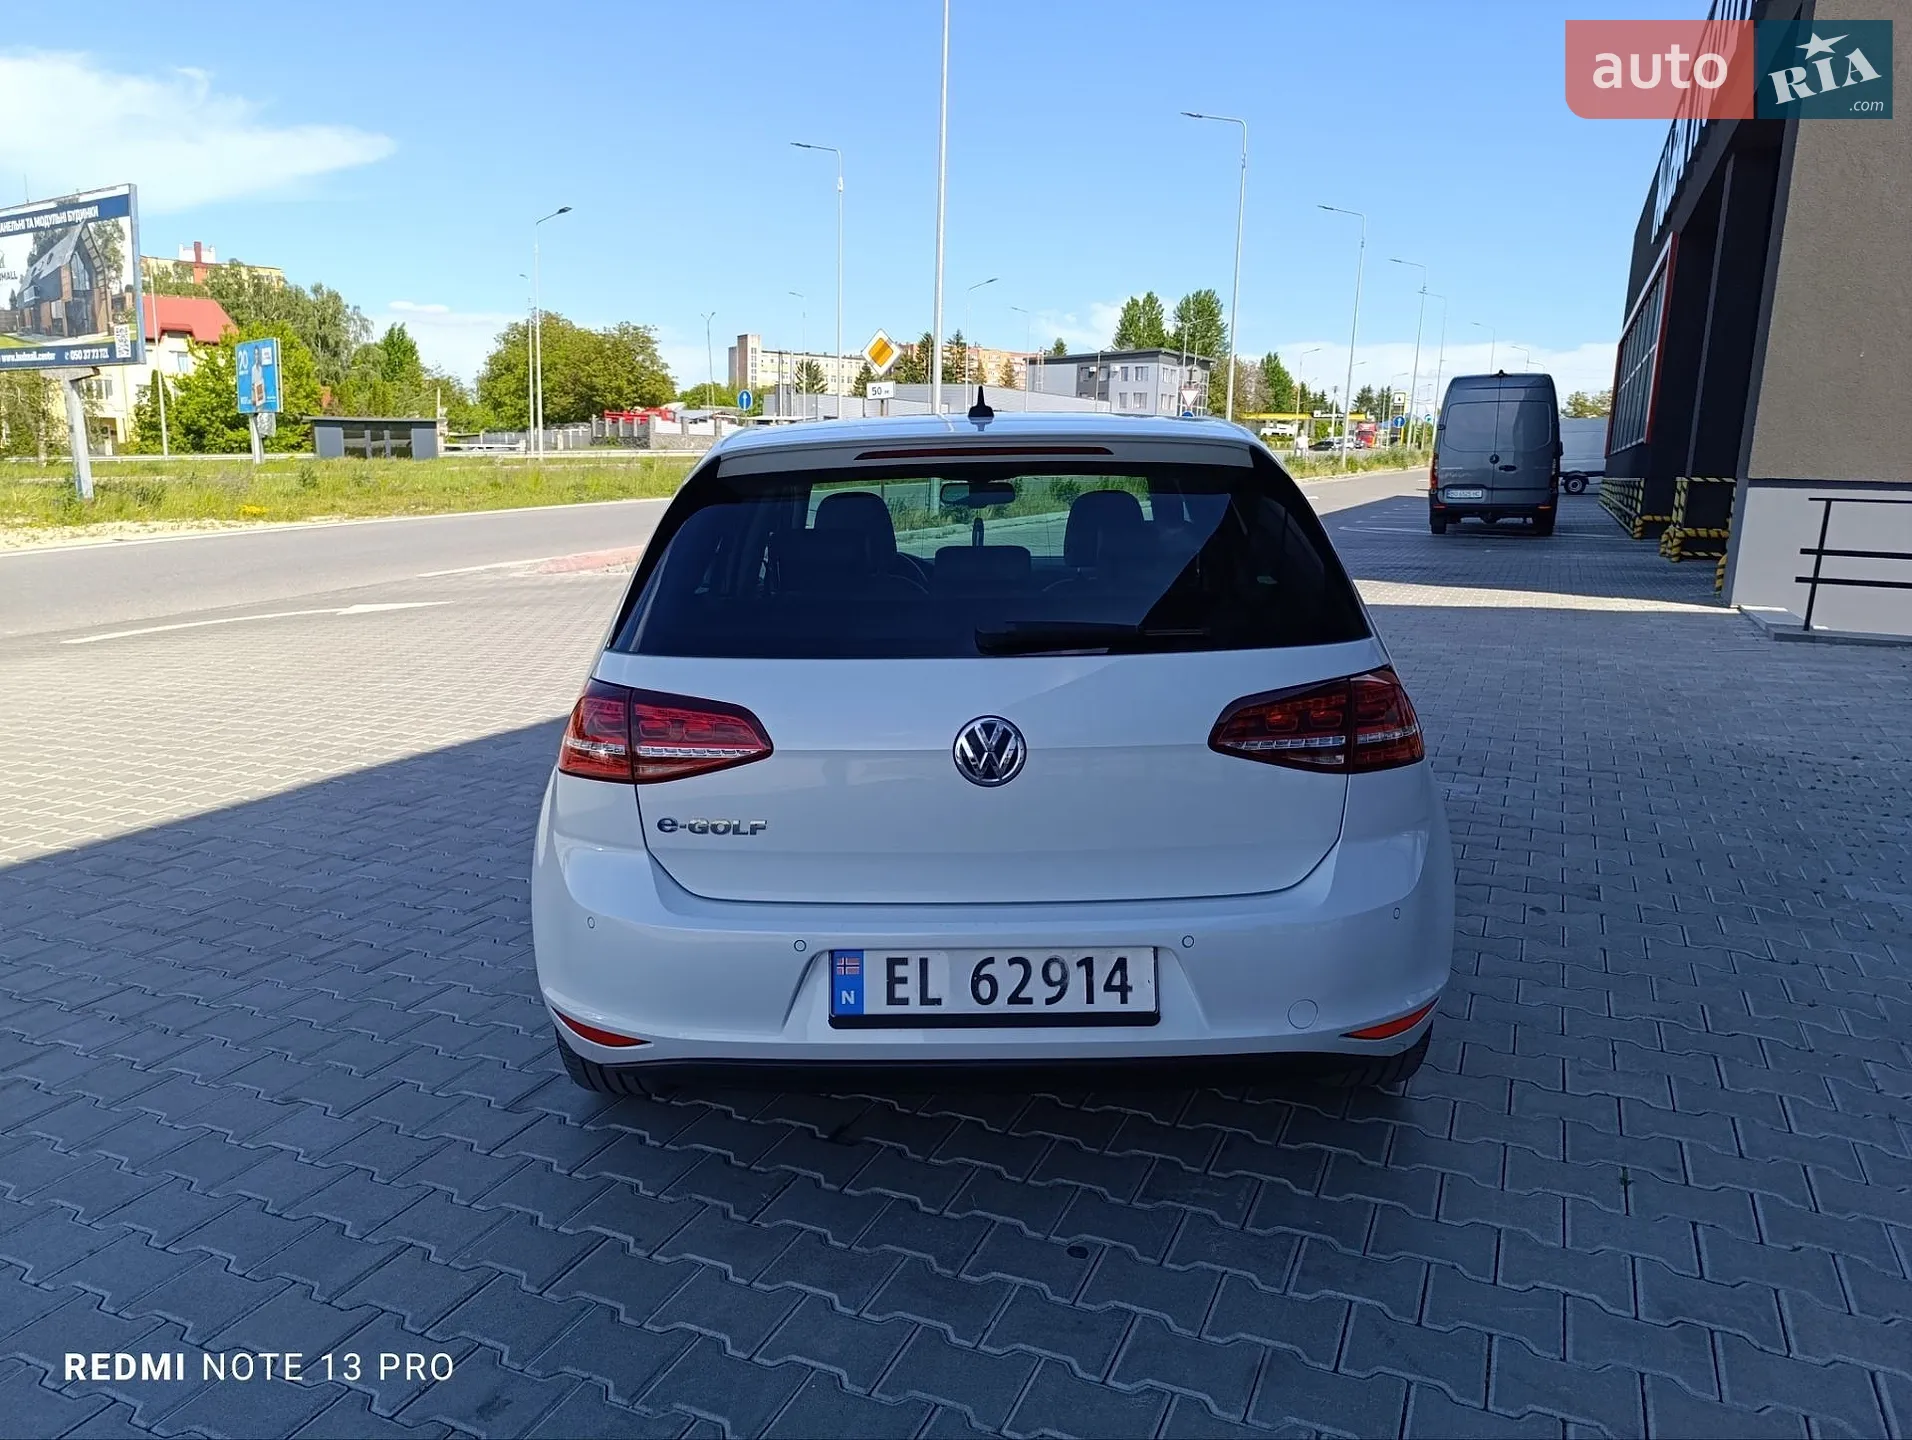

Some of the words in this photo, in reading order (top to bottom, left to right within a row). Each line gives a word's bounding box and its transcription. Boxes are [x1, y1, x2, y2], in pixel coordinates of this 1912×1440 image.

[871, 386, 882, 396] 50
[657, 817, 768, 836] e-GOLF
[841, 990, 855, 1005] N
[885, 956, 943, 1006] EL
[969, 955, 1133, 1006] 62914
